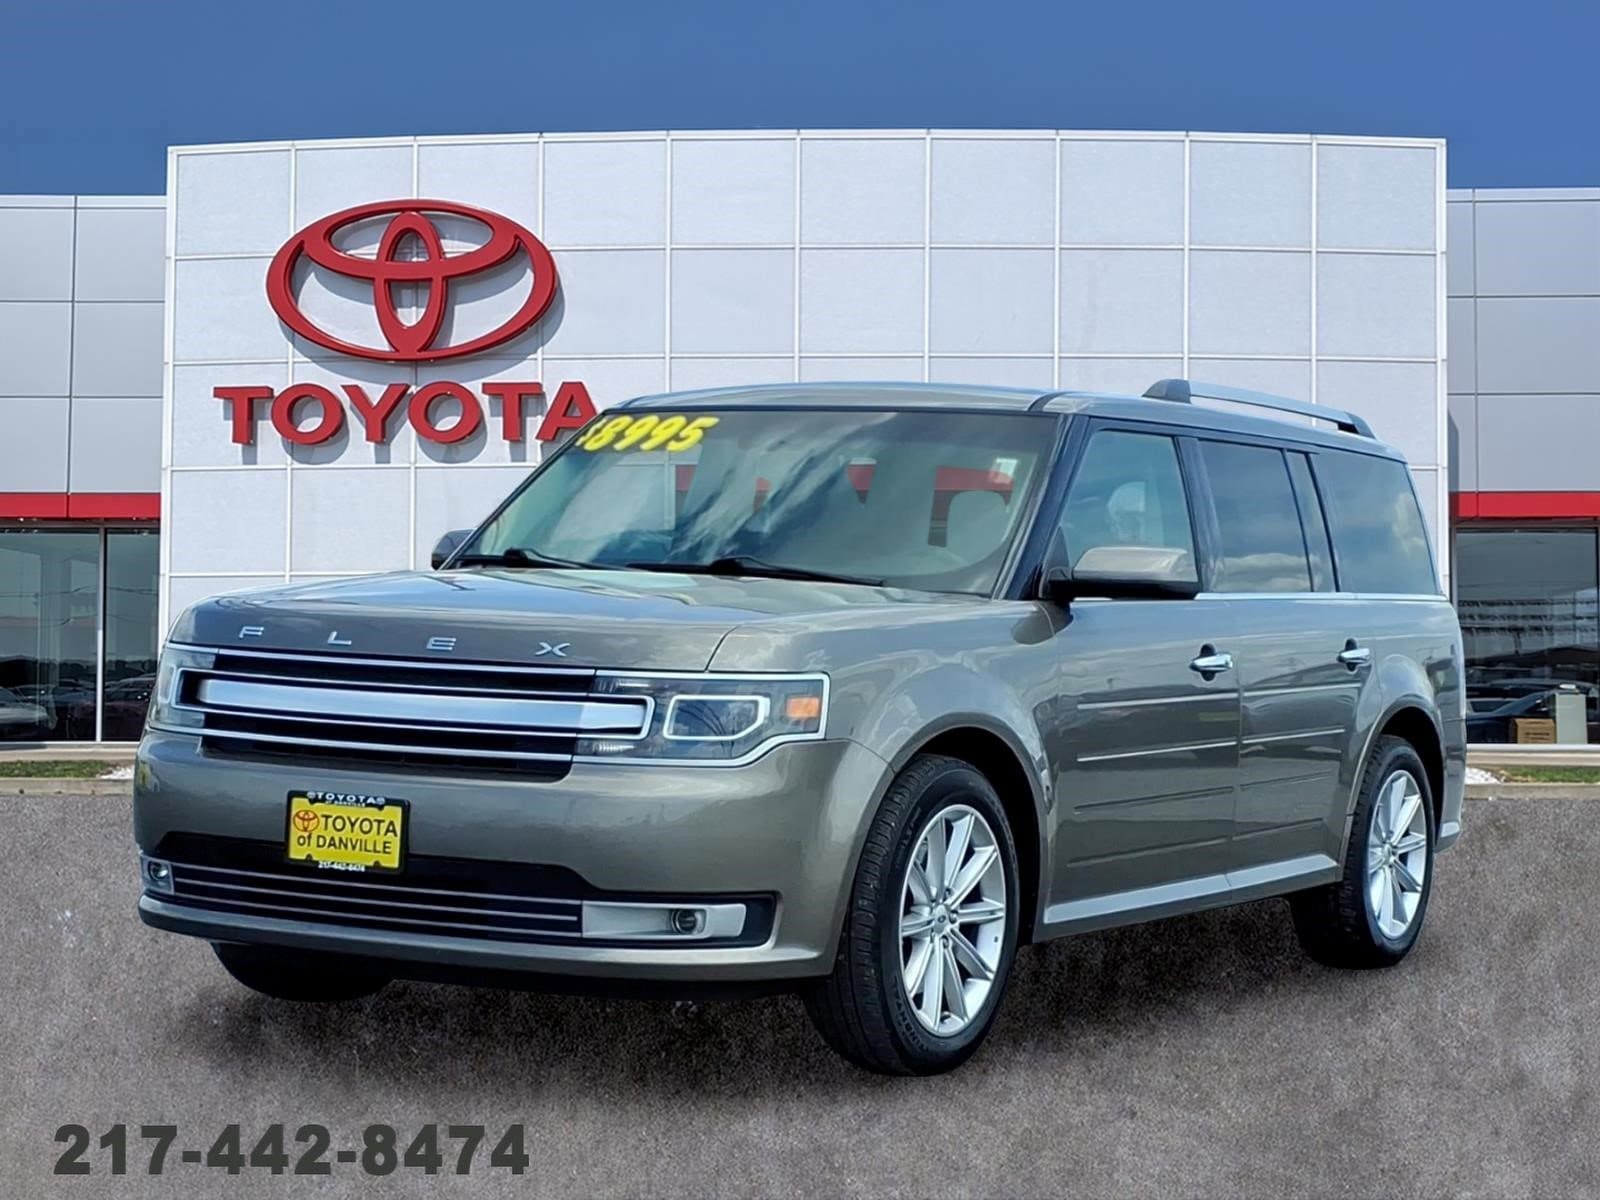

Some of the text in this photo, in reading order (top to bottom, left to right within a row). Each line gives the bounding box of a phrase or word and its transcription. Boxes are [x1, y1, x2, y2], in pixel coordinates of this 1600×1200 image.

[213, 381, 597, 445] TOYOTA
[238, 625, 571, 657] FLEX
[317, 791, 376, 804] TOYOTA
[321, 814, 397, 837] TOYOTA
[297, 833, 392, 854] of DANVILLE
